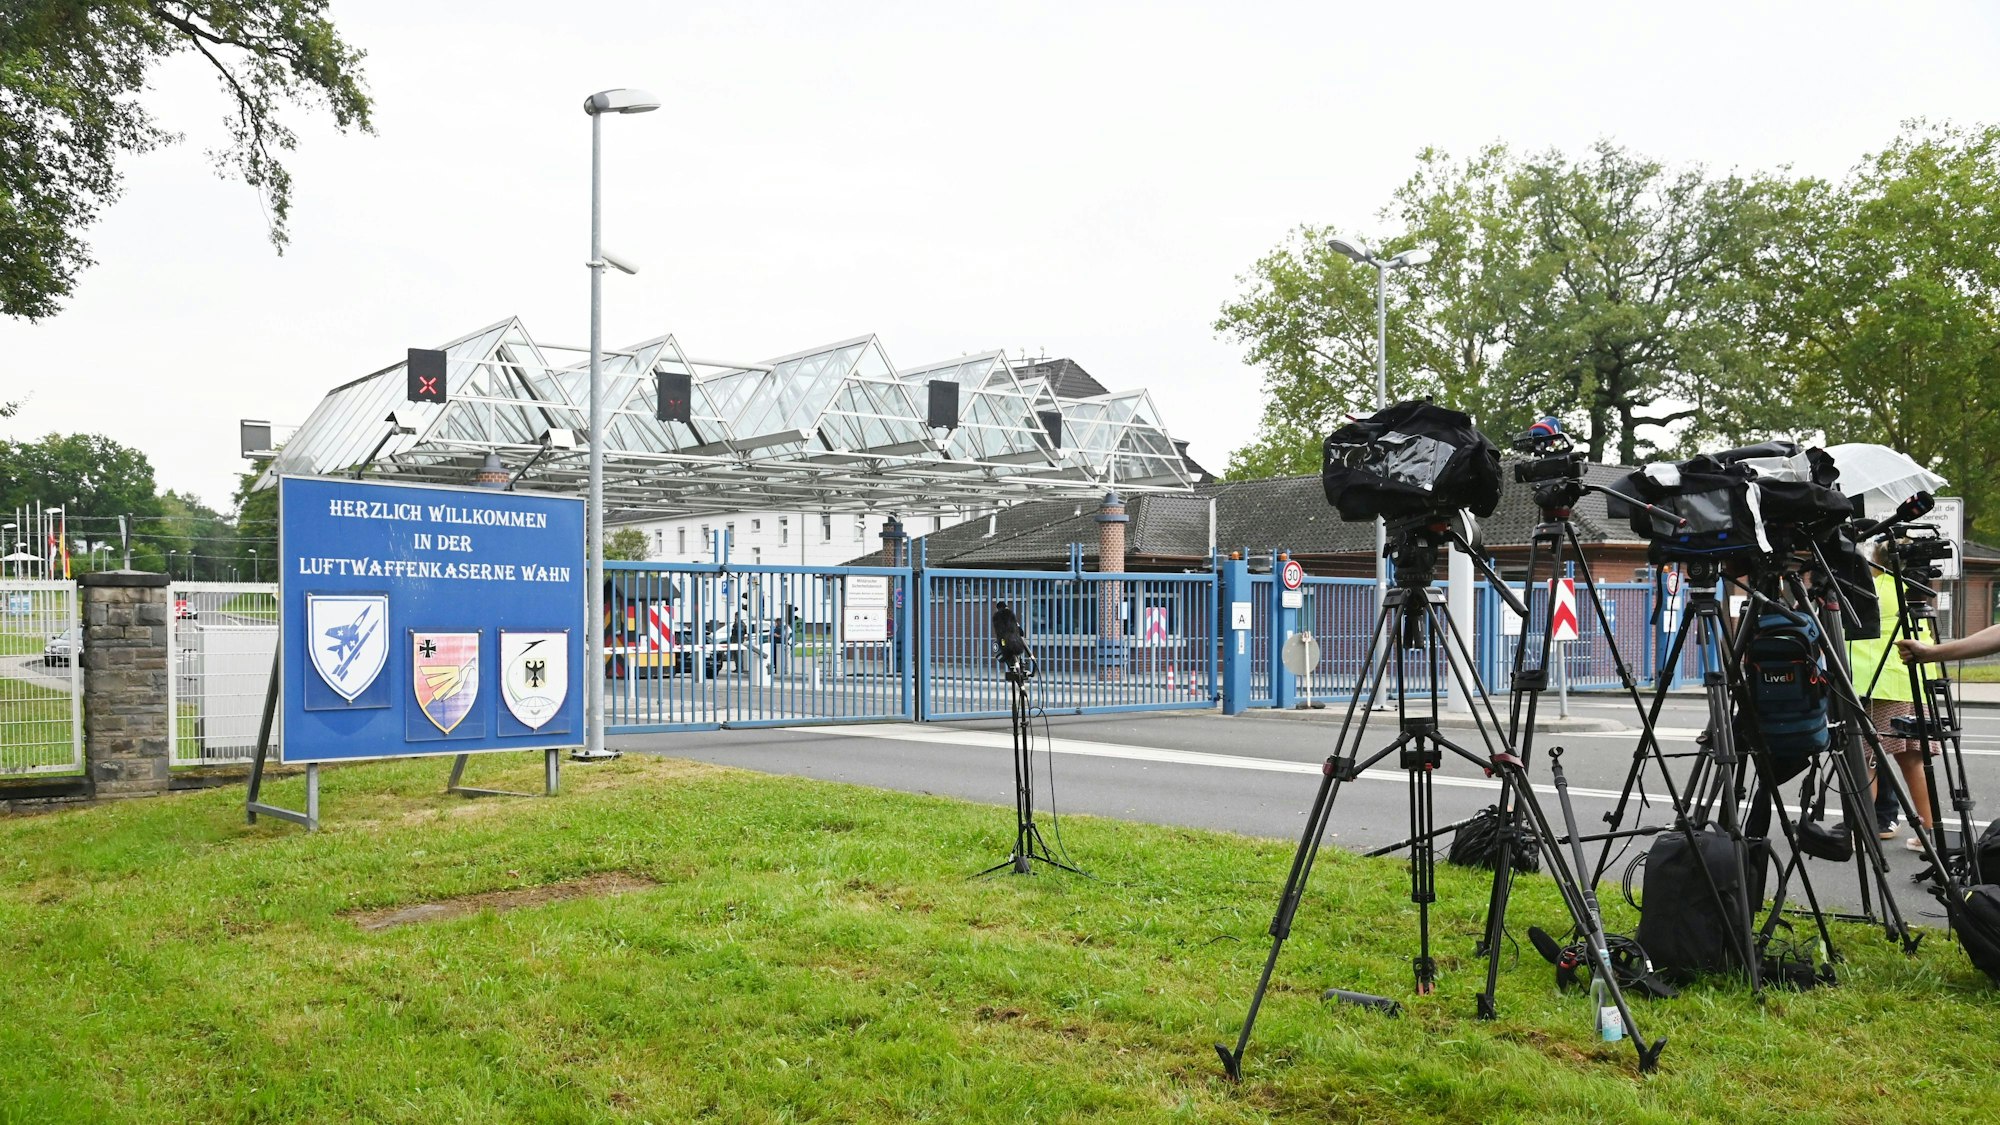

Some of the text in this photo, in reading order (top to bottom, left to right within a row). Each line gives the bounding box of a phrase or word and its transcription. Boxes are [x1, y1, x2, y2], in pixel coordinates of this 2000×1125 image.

[329, 499, 548, 529] HERZLICH WILLKOMMEN
[413, 532, 474, 553] IN DER
[299, 556, 571, 583] LUFTWAFFENKASERNE WAHN
[1287, 569, 1298, 581] 30
[1238, 614, 1245, 624] A
[1764, 672, 1794, 683] LiveU
